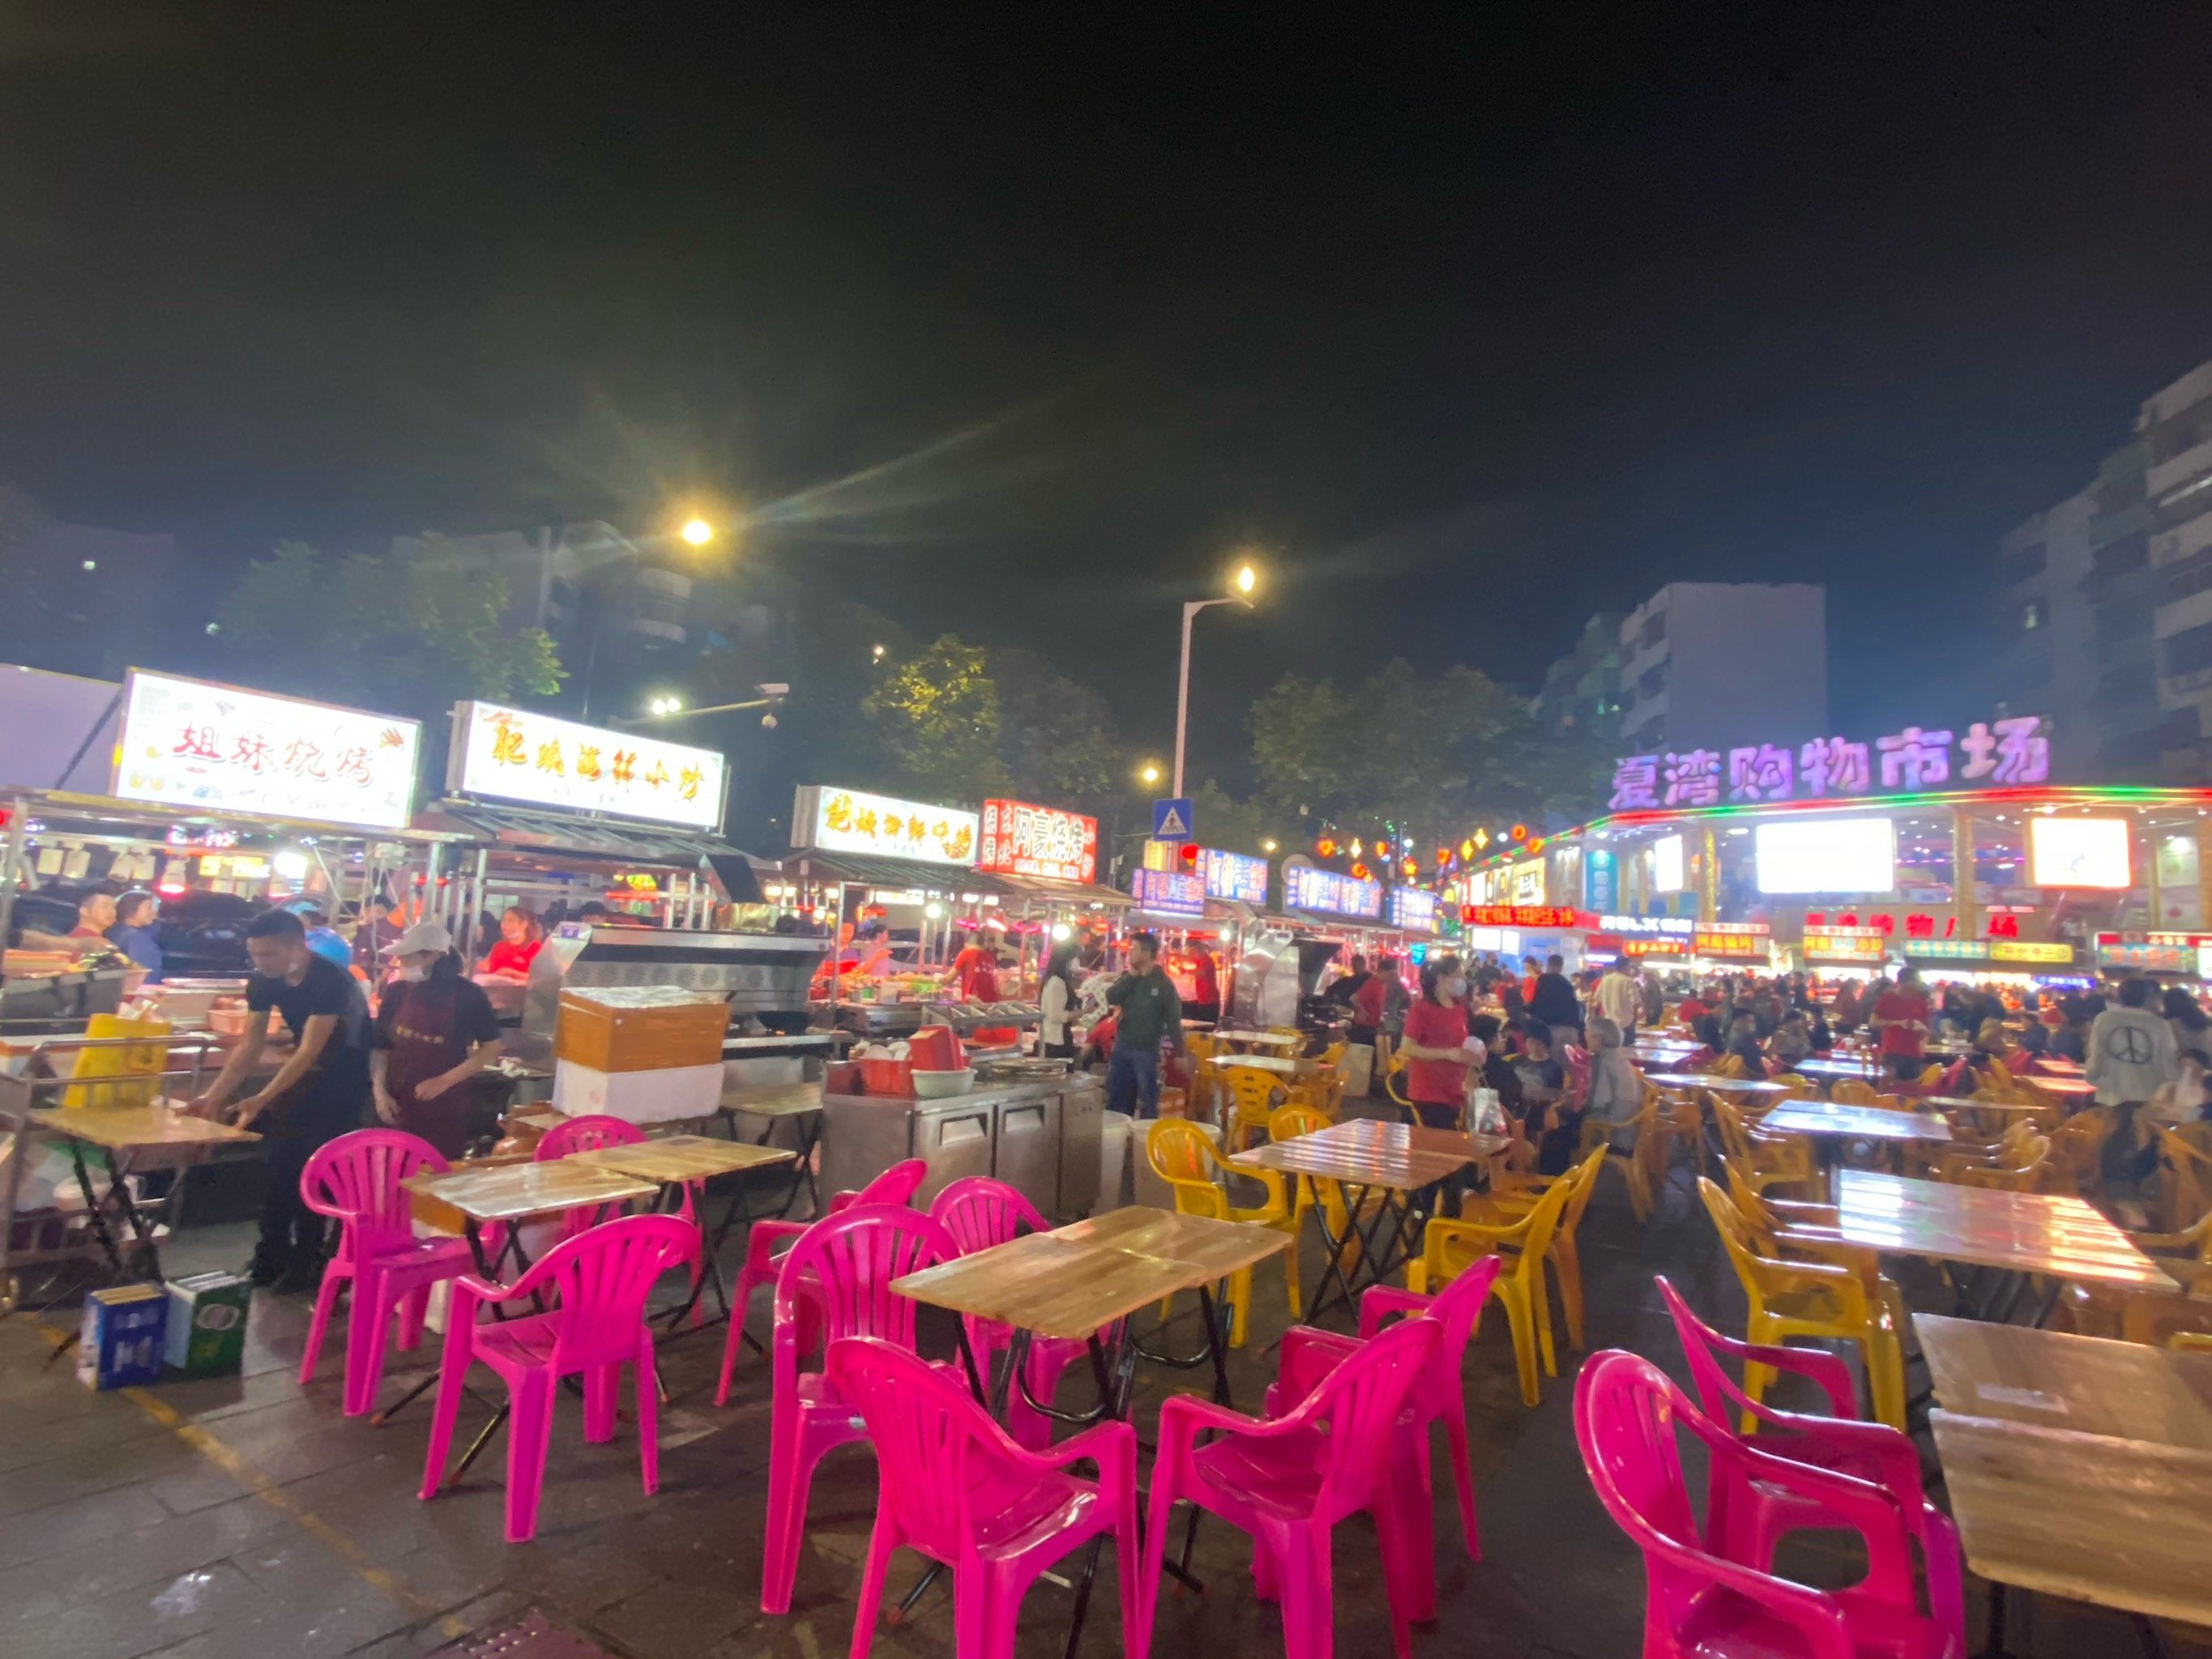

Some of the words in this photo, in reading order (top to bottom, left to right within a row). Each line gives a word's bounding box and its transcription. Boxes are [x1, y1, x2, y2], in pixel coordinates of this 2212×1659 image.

[173, 720, 374, 787] 姐妹烧烤
[1608, 716, 2050, 809] 夏湾购物市场
